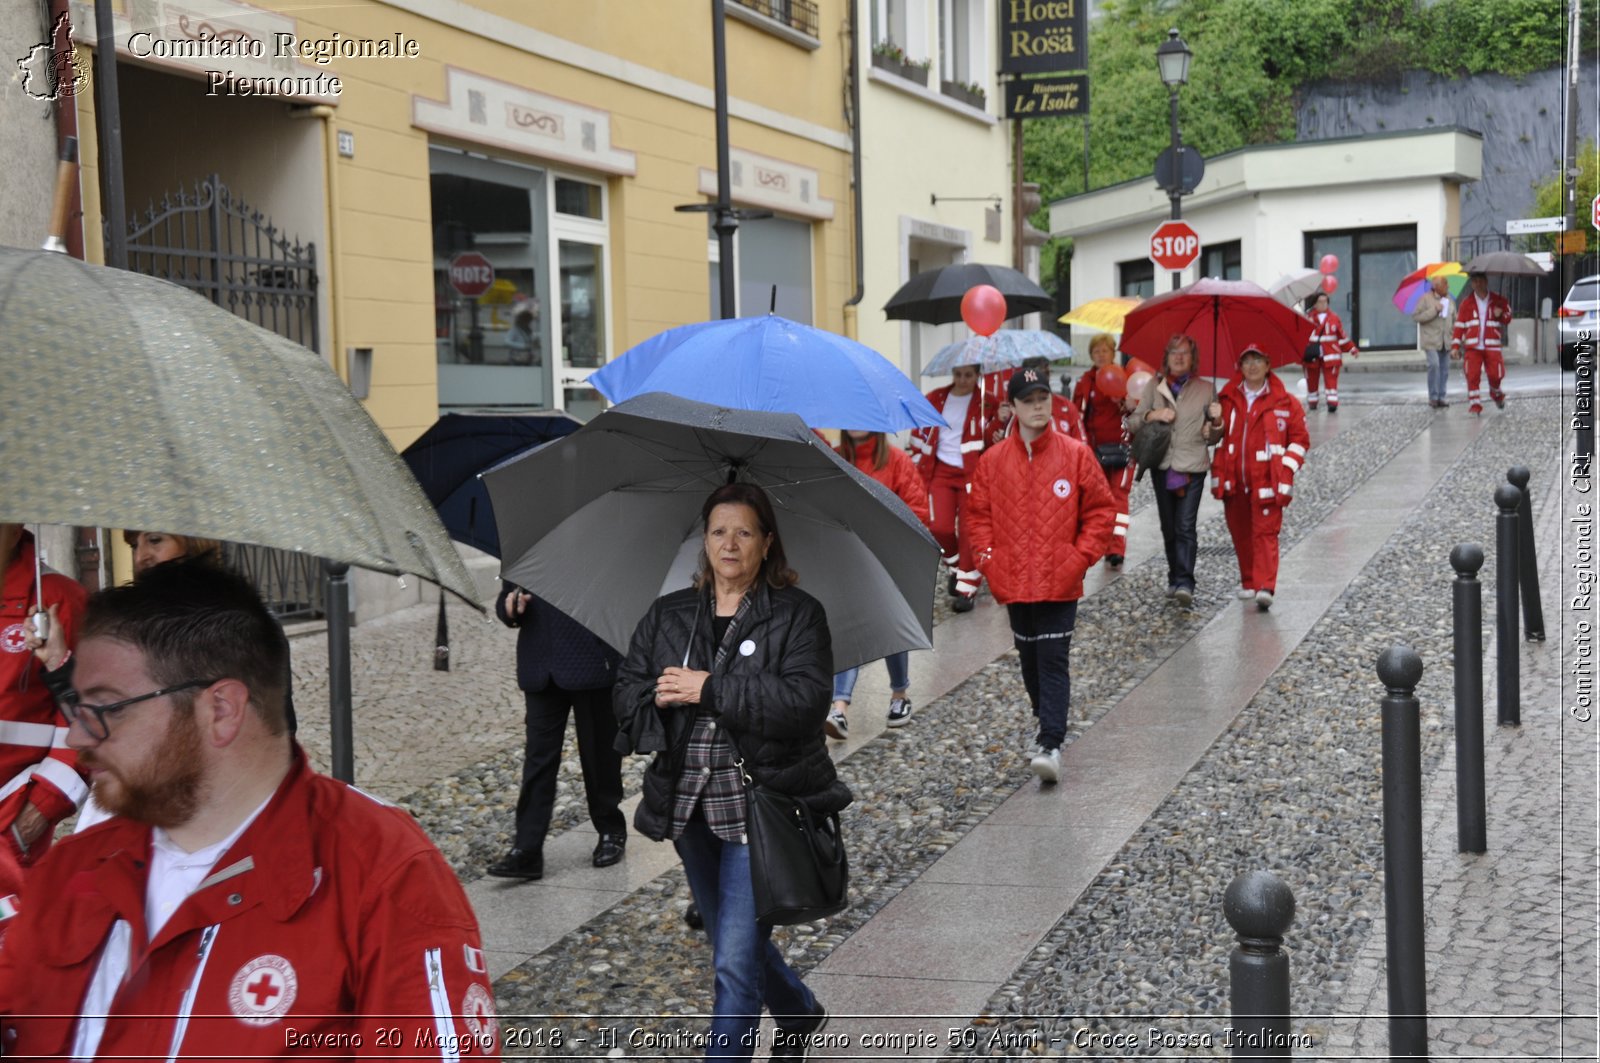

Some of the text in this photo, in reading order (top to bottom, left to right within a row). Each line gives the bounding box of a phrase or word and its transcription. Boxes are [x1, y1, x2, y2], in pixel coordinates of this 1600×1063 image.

[1010, 0, 1074, 23] Hotel
[1010, 30, 1075, 57] Rosa
[1032, 82, 1079, 95] Ristorante
[1014, 91, 1080, 113] Le Isole
[1152, 235, 1198, 257] STOP
